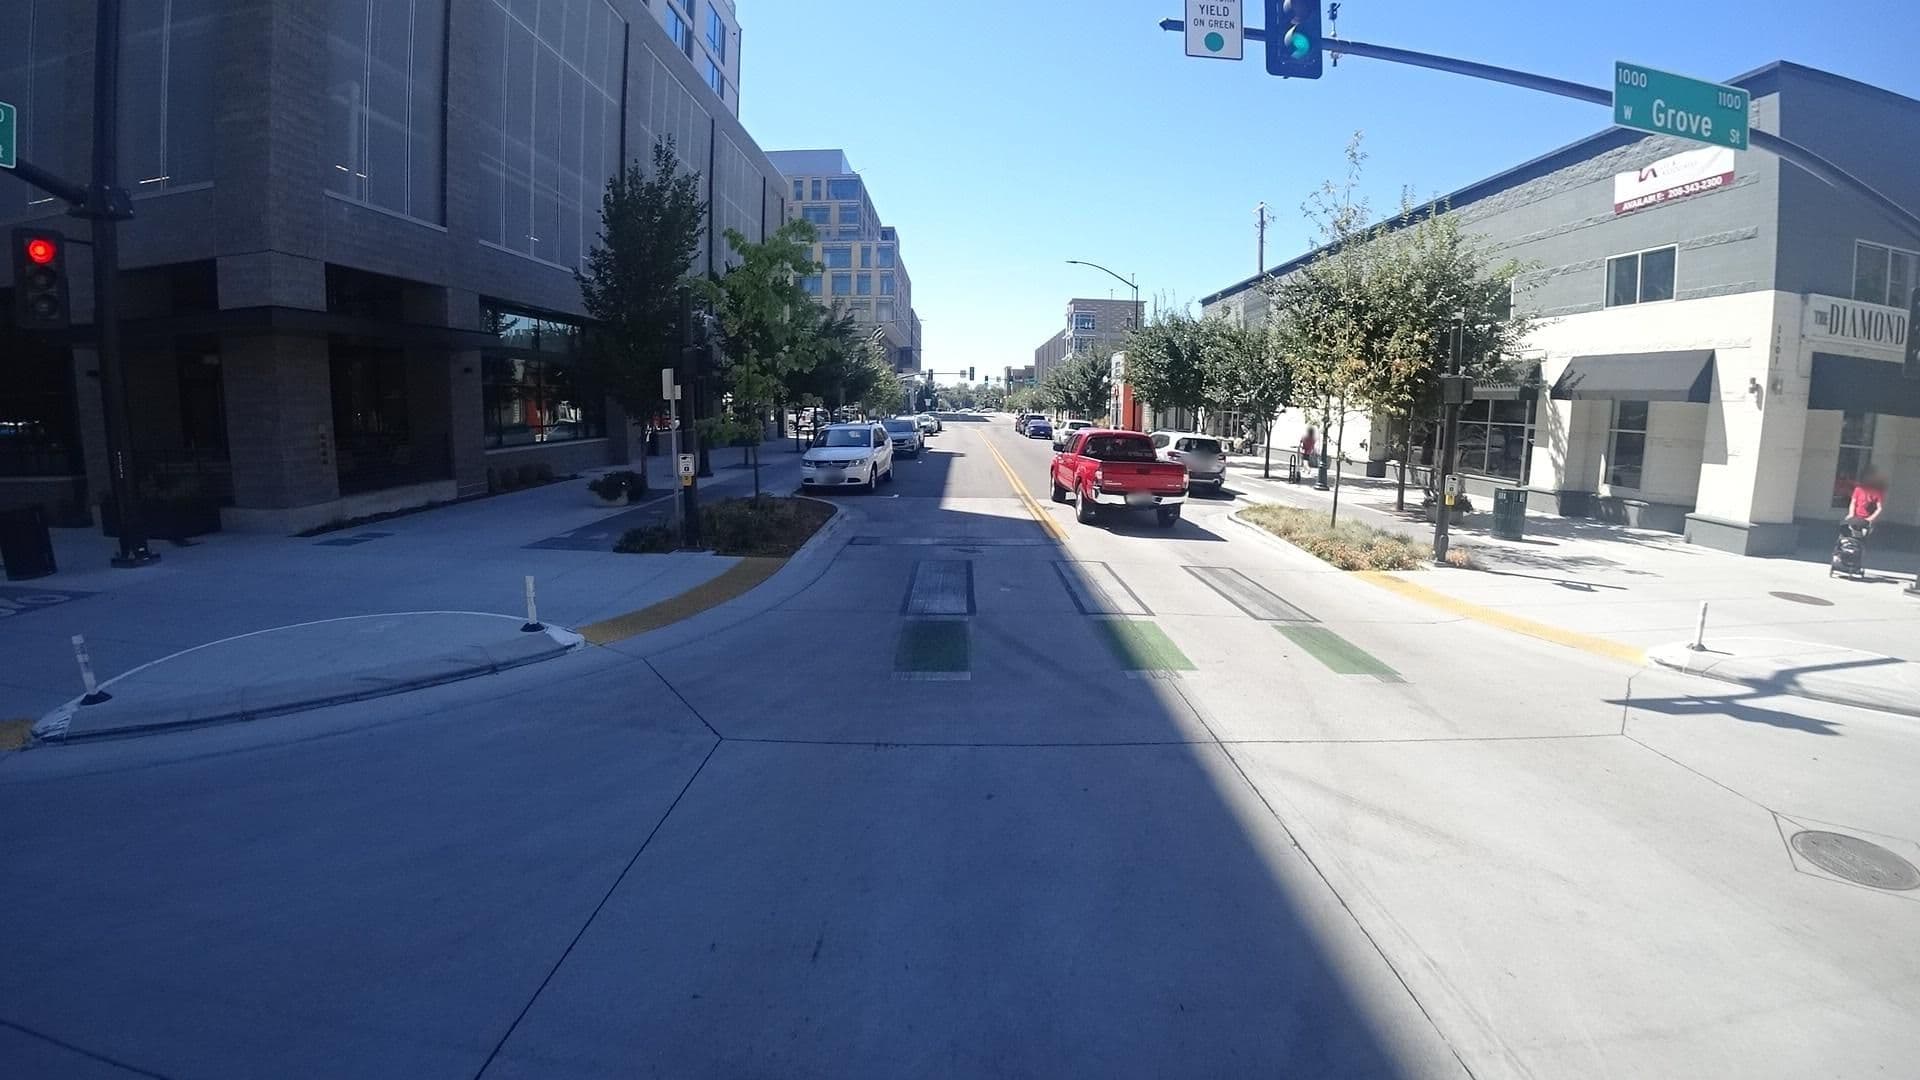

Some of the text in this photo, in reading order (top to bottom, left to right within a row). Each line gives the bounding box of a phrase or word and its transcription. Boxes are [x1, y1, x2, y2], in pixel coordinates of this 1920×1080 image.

[1199, 4, 1230, 17] YIELD
[1194, 18, 1234, 29] ON GREEN
[1618, 68, 1647, 87] 1000
[1718, 91, 1741, 110] 1100
[1623, 99, 1740, 144] W Grove St
[1814, 303, 1906, 345] THE DIAMOND
